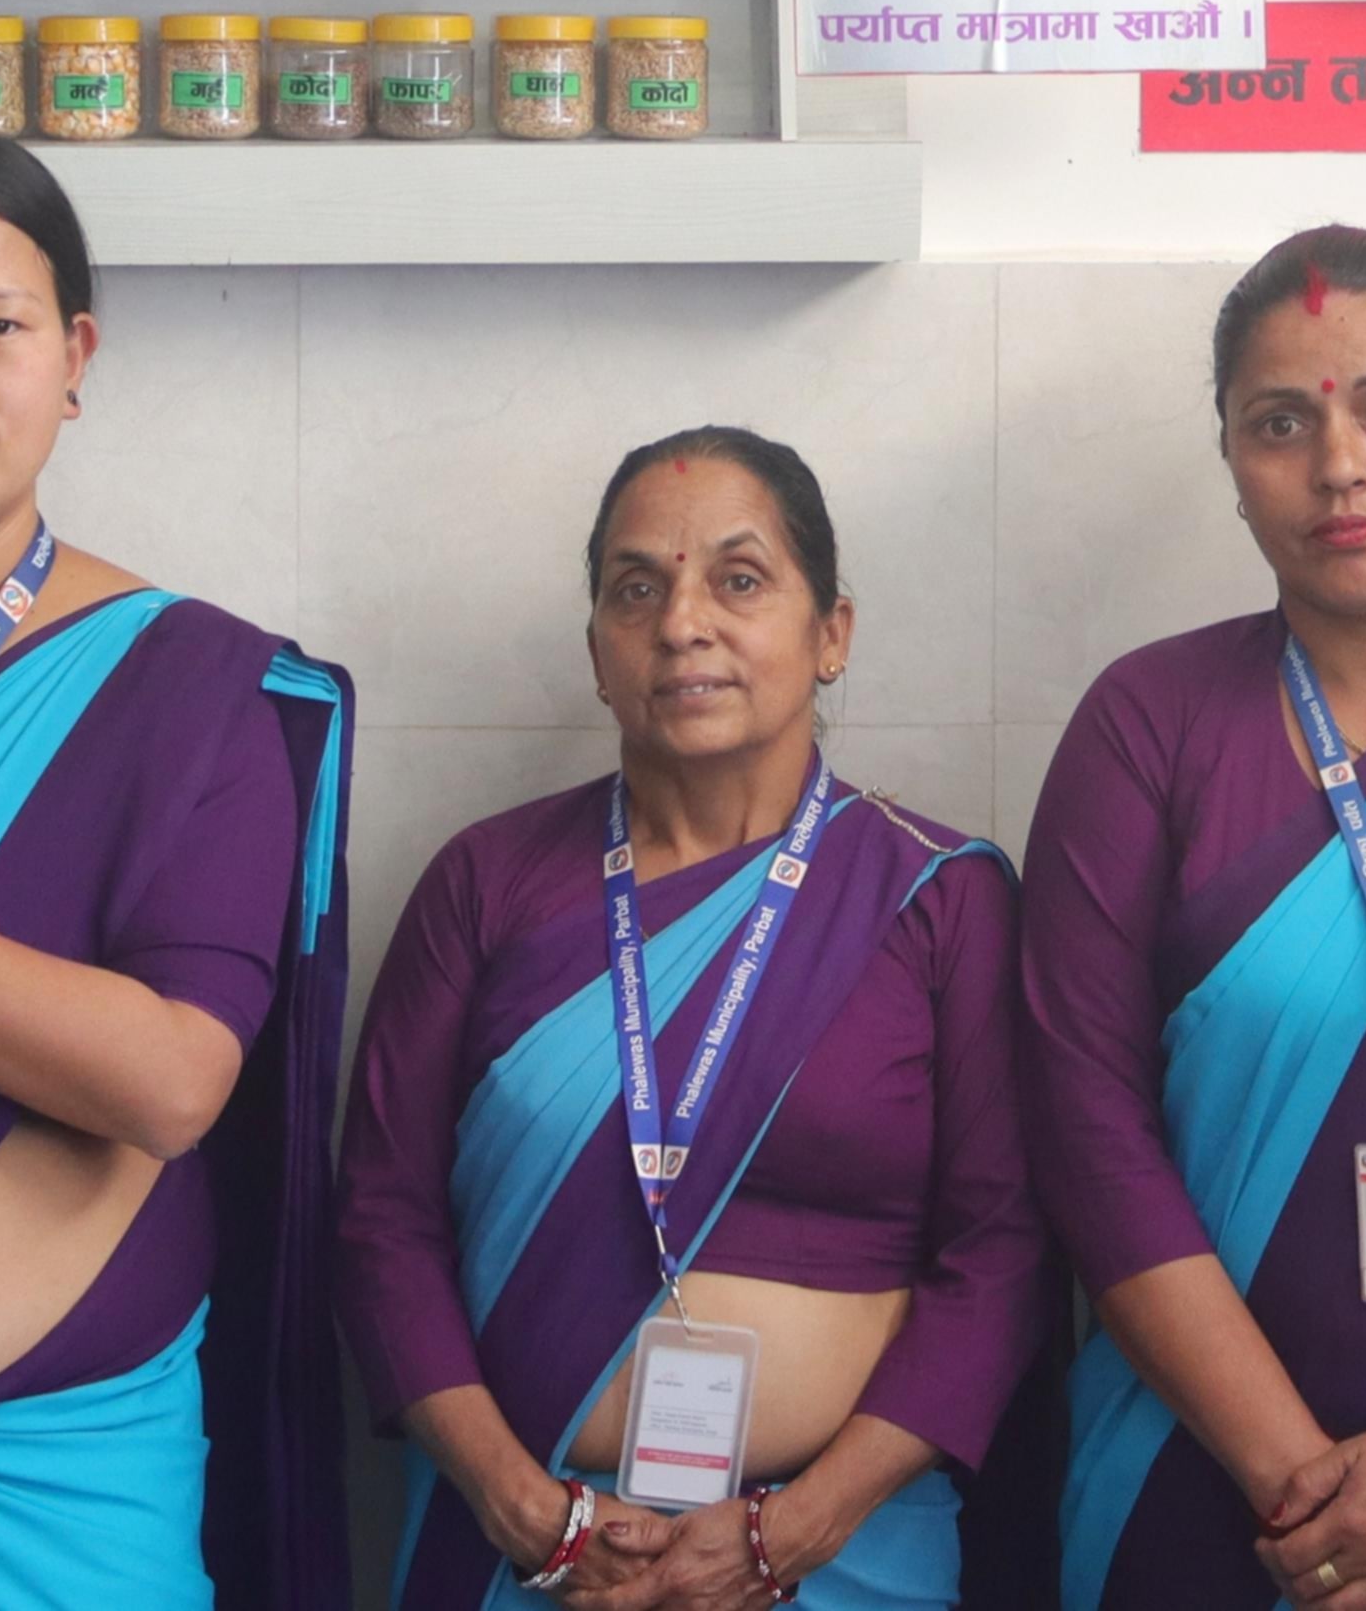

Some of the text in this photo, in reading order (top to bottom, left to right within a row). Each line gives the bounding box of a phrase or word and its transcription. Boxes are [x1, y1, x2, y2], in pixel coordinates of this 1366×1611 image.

[817, 4, 943, 45] पर्याप्त
[956, 11, 1100, 43] मात्रामा
[640, 81, 691, 106] कोदो
[1313, 700, 1339, 759] Phalewas
[789, 799, 824, 855] फलेवास
[1343, 799, 1364, 831] पर्वत
[615, 893, 652, 1111] Phalewas Municipality, Parbat
[675, 905, 778, 1120] Phalewas Municipality, Parbat
